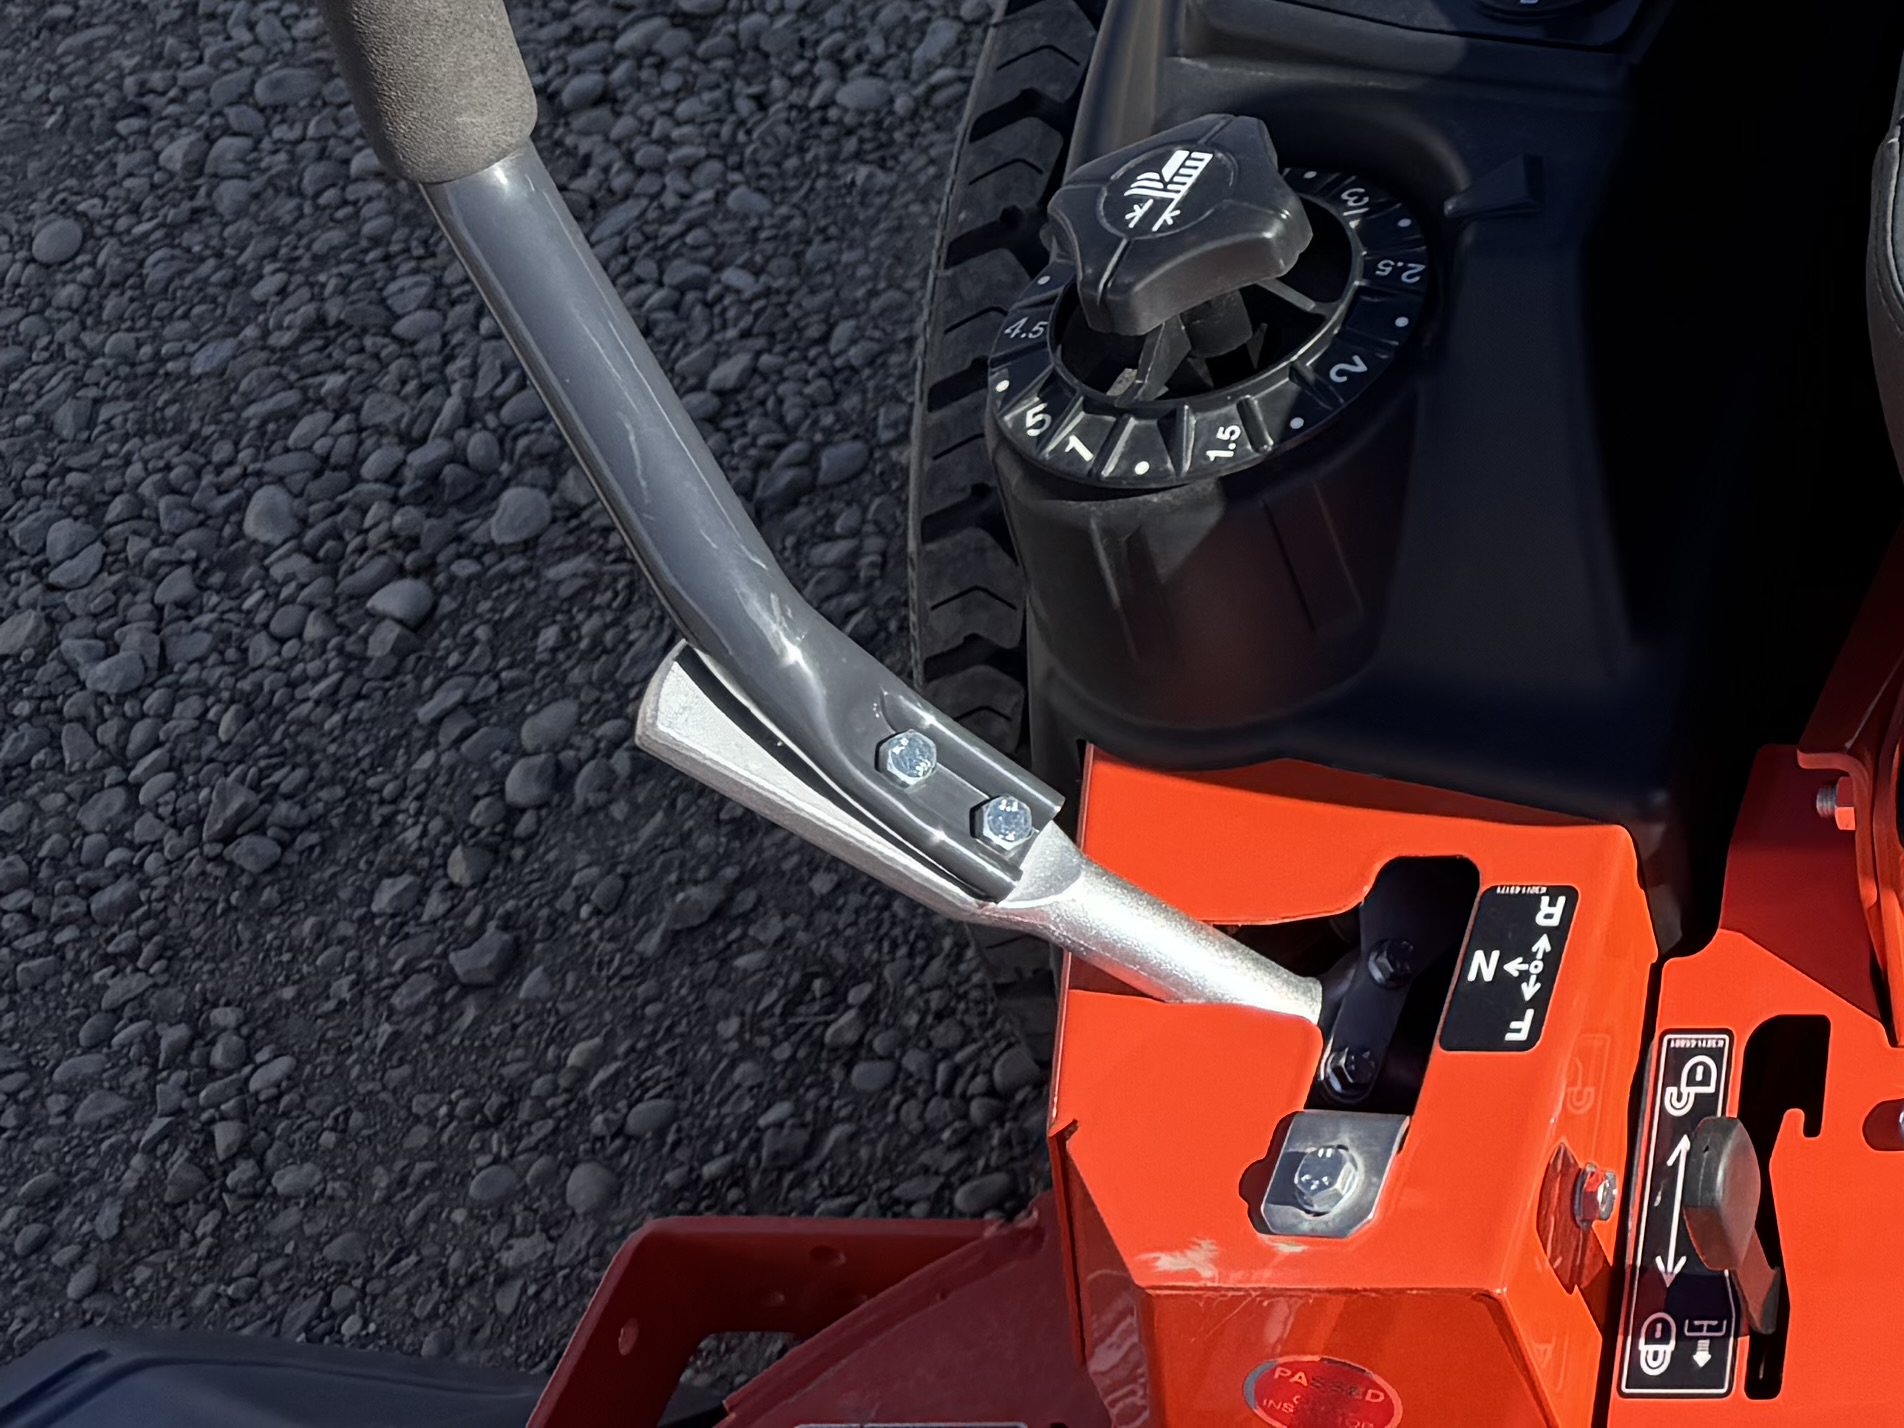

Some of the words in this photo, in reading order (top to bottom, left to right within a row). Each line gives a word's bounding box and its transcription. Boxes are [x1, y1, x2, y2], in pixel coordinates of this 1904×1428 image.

[1375, 258, 1427, 285] 2.5
[1004, 319, 1045, 339] 4.5
[1330, 353, 1368, 384] 2
[1024, 402, 1053, 438] 5
[1064, 433, 1095, 463] 1
[1206, 425, 1242, 462] 1.5
[1534, 896, 1567, 927] R
[1467, 949, 1500, 983] N
[1504, 1007, 1535, 1042] F
